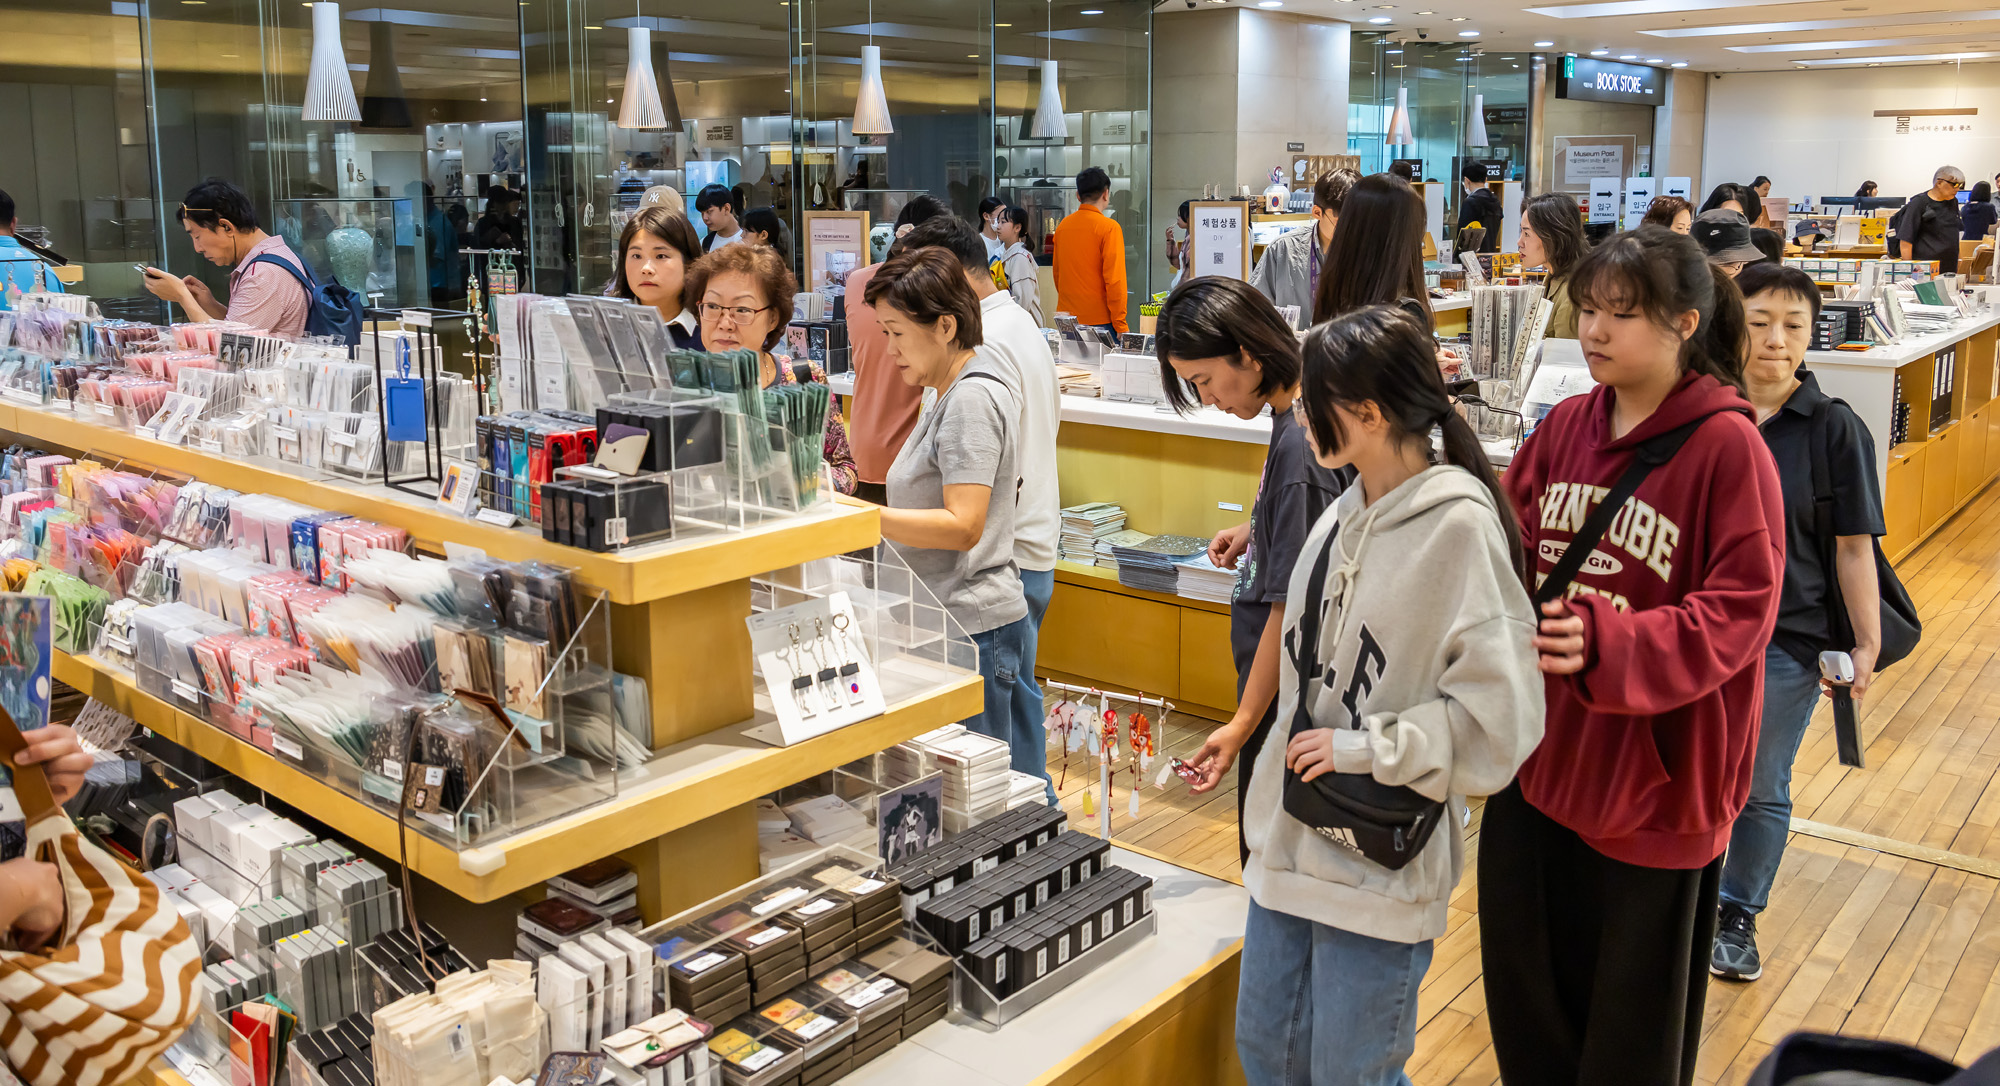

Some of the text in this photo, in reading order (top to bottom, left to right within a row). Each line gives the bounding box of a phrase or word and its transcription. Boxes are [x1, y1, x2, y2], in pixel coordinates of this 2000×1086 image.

[1597, 72, 1641, 93] BOOK STORE
[1597, 203, 1612, 212] 입구
[1633, 201, 1647, 209] 입구
[1202, 218, 1237, 228] 체험상품
[1541, 543, 1613, 570] DEGN
